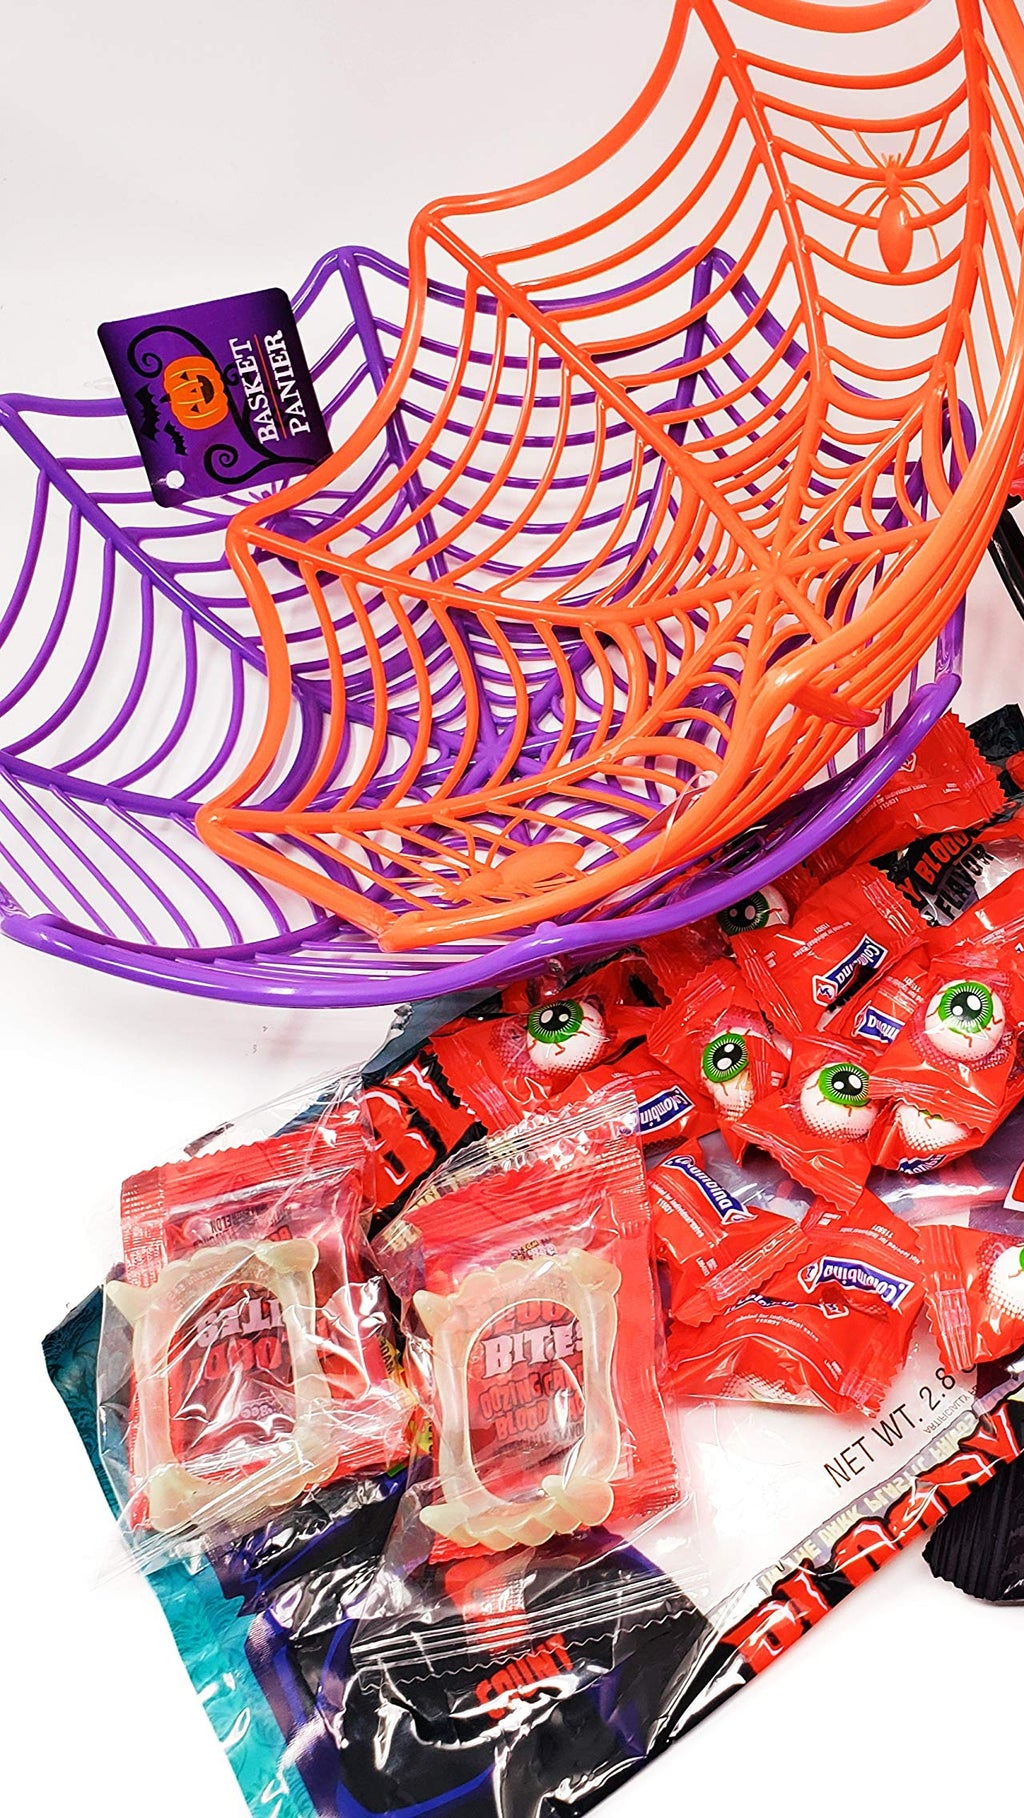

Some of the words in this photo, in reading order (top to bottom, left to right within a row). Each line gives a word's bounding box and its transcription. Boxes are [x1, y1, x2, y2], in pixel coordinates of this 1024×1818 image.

[229, 337, 279, 444] BASKET
[264, 329, 311, 437] PANIER
[913, 831, 970, 886] BLOOD
[934, 842, 995, 921] FLAVOR
[769, 1313, 804, 1330] individual
[494, 1402, 548, 1441] BLOOD
[823, 1436, 875, 1488] NET
[871, 1403, 924, 1447] WT.
[918, 1367, 956, 1412] 2.8
